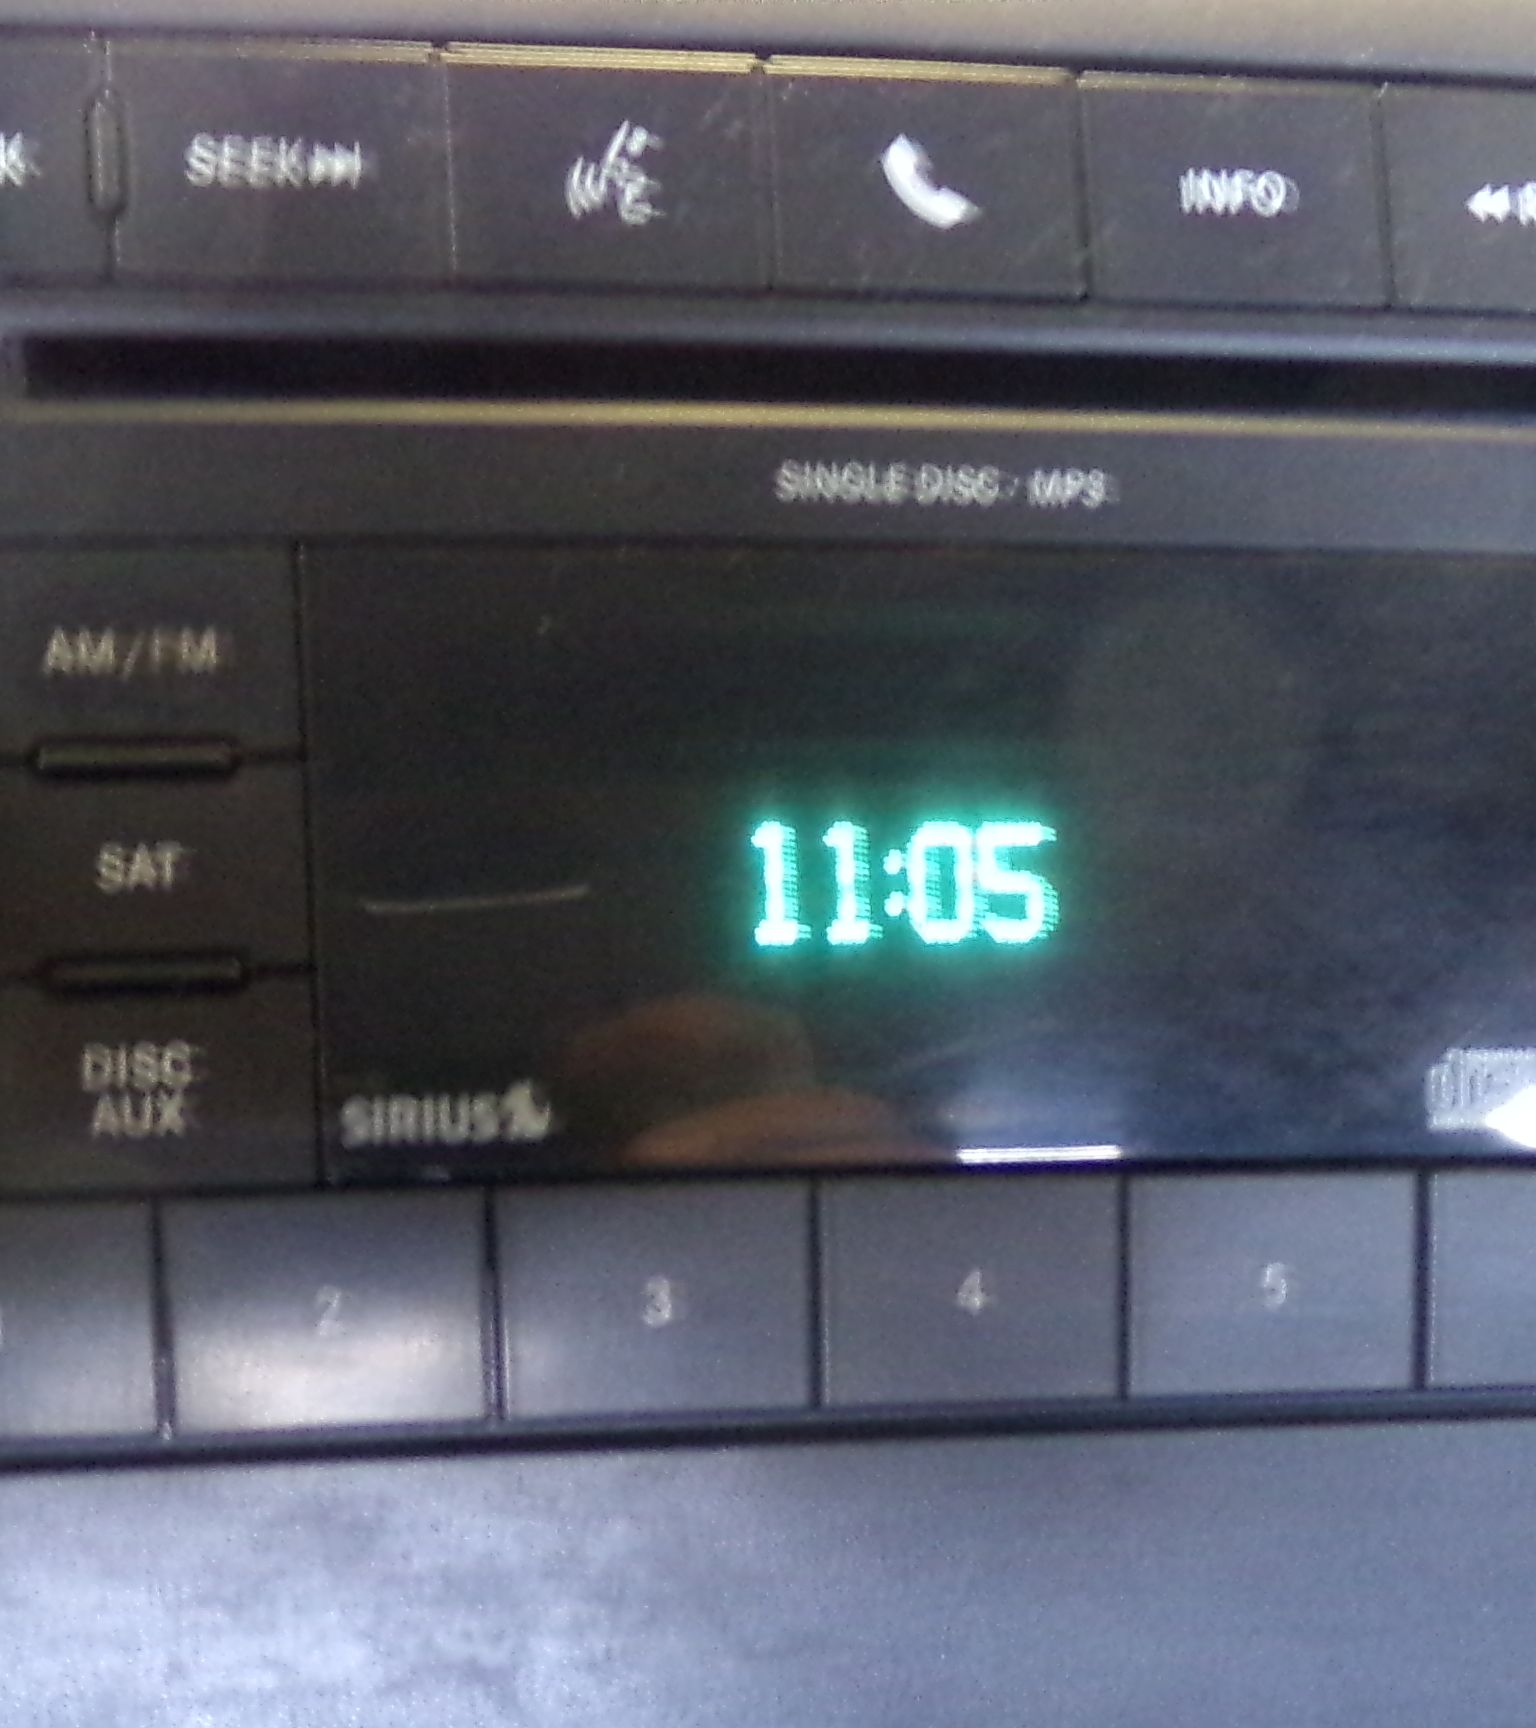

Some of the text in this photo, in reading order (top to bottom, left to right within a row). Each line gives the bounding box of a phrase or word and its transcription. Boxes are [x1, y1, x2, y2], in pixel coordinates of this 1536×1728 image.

[184, 132, 304, 188] SEEK
[1179, 168, 1294, 217] INFO
[775, 459, 1110, 509] SINGLE DISC MP3
[41, 625, 221, 681] AM/FM
[95, 841, 186, 893] SAT
[749, 817, 1060, 948] 11:05
[80, 1040, 202, 1092] DISC
[90, 1092, 189, 1139] AUX
[339, 1093, 499, 1149] SIRIUS
[313, 1283, 347, 1337] 2
[641, 1276, 676, 1329] 3
[955, 1267, 990, 1315] 4
[1261, 1260, 1292, 1309] 5
